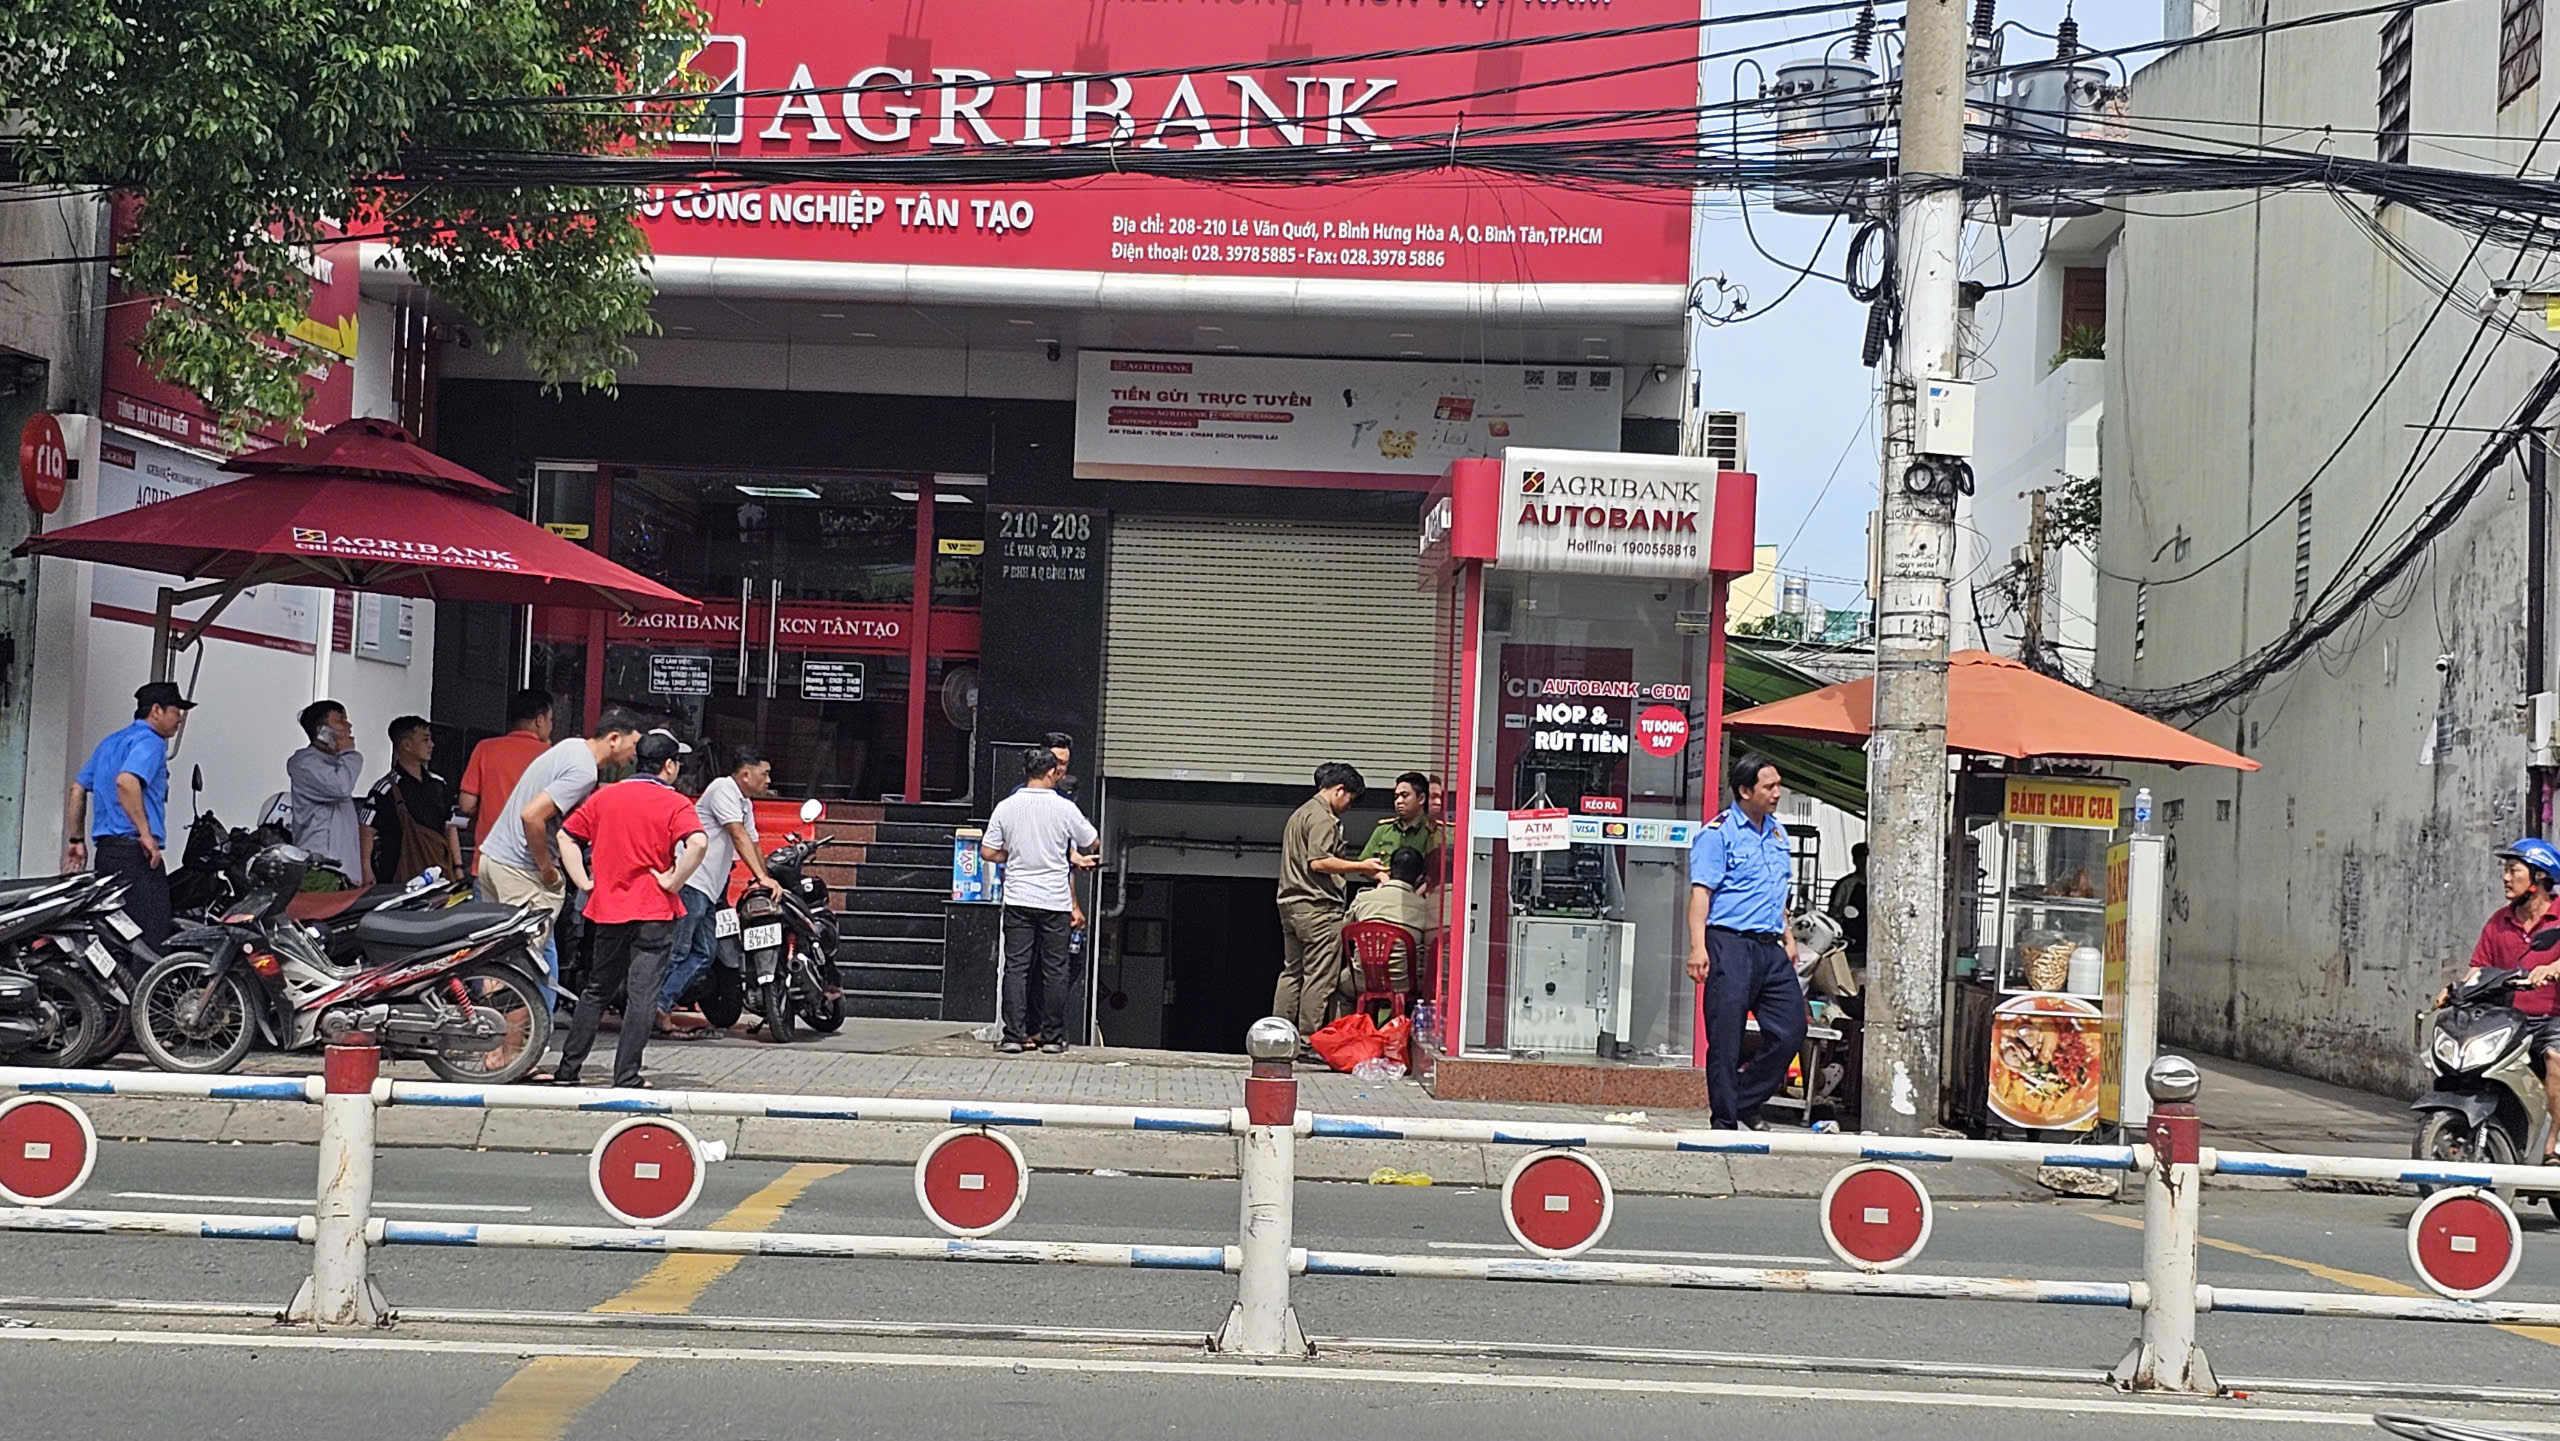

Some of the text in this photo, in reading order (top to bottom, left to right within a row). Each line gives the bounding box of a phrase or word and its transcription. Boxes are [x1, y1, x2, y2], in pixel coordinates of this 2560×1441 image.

[759, 63, 1398, 154] AGRIBANK
[672, 182, 762, 221] CÔNG
[769, 190, 885, 230] NGHIỆP
[896, 191, 959, 228] TÂN
[971, 199, 1034, 234] TẠO
[1111, 215, 1136, 236] Địa
[1140, 213, 1164, 234] chỉ:
[1169, 218, 1226, 236] 208-210
[1231, 219, 1248, 236] Lê
[1253, 219, 1279, 238] Văn
[1282, 220, 1320, 241] Quới,
[1323, 221, 1336, 239] P.
[1338, 219, 1369, 239] Bình
[1373, 223, 1411, 245] Hưng
[1416, 223, 1445, 241] Hòa
[1449, 225, 1464, 244] A,
[1467, 225, 1482, 243] Q.
[1485, 224, 1516, 242] Bình
[1111, 242, 1144, 262] Điện
[1147, 242, 1188, 263] thoại:
[1307, 247, 1337, 264] Fax:
[1127, 363, 1190, 374] AGRIBANK
[1198, 392, 1247, 408] TRỰC
[37, 429, 63, 479] ria
[1550, 474, 1700, 501] AGRIBANK
[1517, 503, 1699, 533] AUTOBANK
[295, 543, 328, 552] CHI
[400, 552, 438, 562] KCN
[331, 535, 517, 562] AGRIBANK
[1074, 546, 1086, 559] 26
[1567, 538, 1697, 558] Hotline: 1900558818
[637, 613, 900, 640] AGRIBANK KCN TÂN TẠO
[1542, 679, 1640, 698] AUTOBANK
[1651, 683, 1691, 700] CDM
[1536, 702, 1588, 726] NỘP
[1590, 706, 1608, 726] &
[1534, 729, 1577, 751] RÚT
[1585, 799, 1617, 811] KÉO RA
[2010, 785, 2114, 820] BÁNH CANH CUA
[1525, 823, 1553, 833] ATM
[1576, 825, 1596, 833] VISA
